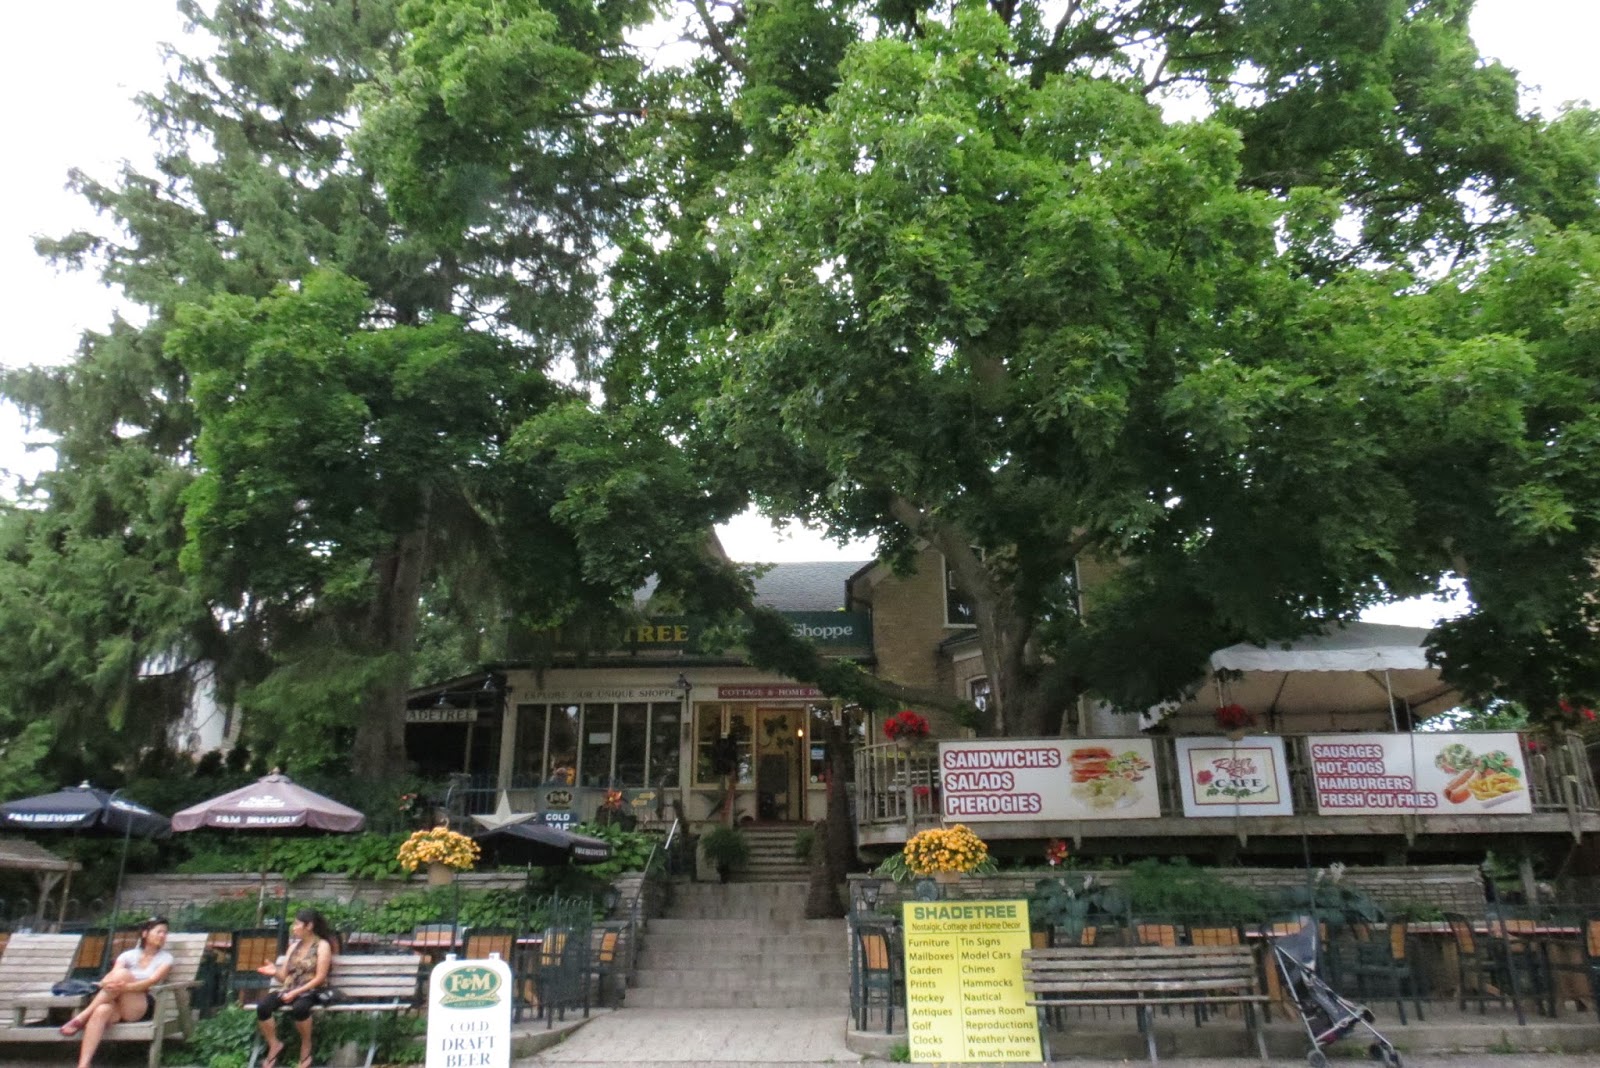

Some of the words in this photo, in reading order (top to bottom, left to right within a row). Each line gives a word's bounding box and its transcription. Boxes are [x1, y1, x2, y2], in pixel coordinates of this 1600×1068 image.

[624, 625, 689, 643] TREE
[792, 624, 853, 639] Shoppe
[598, 690, 634, 699] UNIQUE
[639, 689, 675, 698] SHOPPE
[721, 689, 762, 697] COTTAGE
[778, 688, 804, 696] HOME
[407, 709, 475, 721] ADETREE
[1313, 745, 1382, 758] SAUSAGES
[945, 749, 1060, 769] SANDWICHES
[1315, 761, 1384, 774] HOT-DOGS
[945, 772, 1014, 791] SALADS
[1319, 777, 1411, 790] HAMBURGERS
[948, 795, 1041, 813] PIEROGIES
[1321, 793, 1364, 806] FRESH
[1367, 793, 1395, 806] CUT
[1397, 793, 1437, 806] FRIES
[246, 816, 298, 824] BREWERY
[545, 813, 570, 821] COLD
[914, 905, 1017, 920] SHADETREE
[912, 923, 942, 933] Nostalgic,
[943, 923, 967, 932] Cottage
[1002, 921, 1021, 929] Decor
[908, 939, 950, 947] Furniture
[960, 938, 974, 946] Tin
[977, 937, 1001, 948] Signs
[909, 952, 954, 961] Mailboxes
[961, 951, 989, 960] Model
[992, 951, 1011, 959] Cars
[910, 966, 943, 975] Garden
[962, 965, 995, 974] Chimes
[449, 973, 491, 993] F&M
[911, 980, 936, 988] Prints
[963, 979, 1013, 987] Hammocks
[911, 993, 944, 1004] Hockey
[964, 993, 1001, 1001] Nautical
[912, 1007, 952, 1018] Antiques
[965, 1007, 996, 1015] Games
[999, 1007, 1025, 1015] Room
[450, 1021, 489, 1032] COLD
[912, 1021, 931, 1031] Golf
[966, 1021, 1034, 1031] Reproductions
[441, 1035, 496, 1051] DRAFT
[913, 1035, 943, 1045] Clocks
[967, 1035, 1005, 1044] Weather
[1008, 1035, 1036, 1043] Vanes
[914, 1050, 942, 1059] Books
[968, 1049, 976, 1058] &
[977, 1049, 1004, 1057] much
[1006, 1049, 1030, 1057] more
[446, 1052, 491, 1068] BEER
